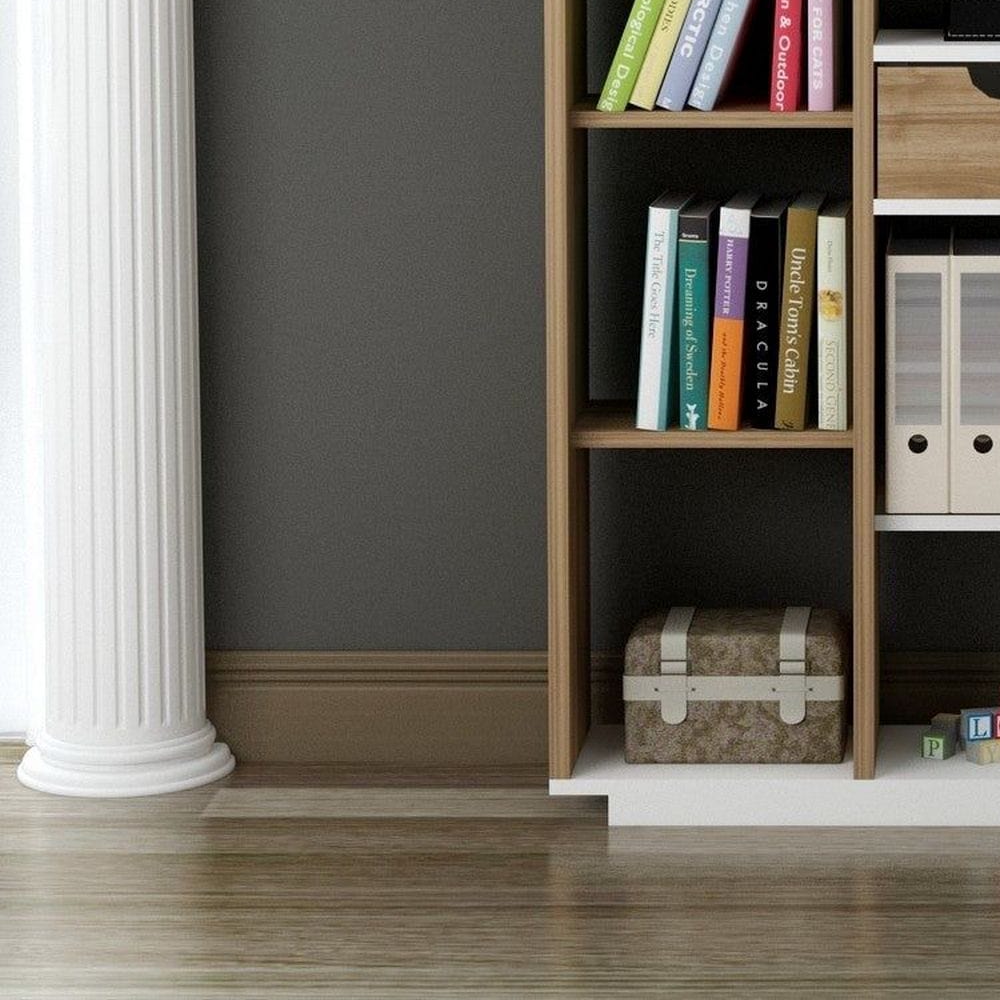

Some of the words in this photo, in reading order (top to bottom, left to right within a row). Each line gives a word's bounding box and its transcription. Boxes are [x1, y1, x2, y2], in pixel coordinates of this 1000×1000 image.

[780, 15, 792, 28] &
[812, 7, 822, 41] FOR
[776, 35, 790, 111] Outdoor
[812, 46, 823, 90] CATS
[654, 231, 665, 252] The
[724, 239, 734, 274] HARRY
[652, 255, 664, 278] Title
[789, 248, 806, 294] Uncle
[683, 268, 697, 327] Dreaming
[722, 275, 732, 314] POTTER
[686, 330, 698, 344] of
[786, 296, 804, 346] Tom's
[686, 344, 698, 390] Sweden
[756, 281, 768, 410] DRACULA
[826, 340, 836, 392] SECOND
[783, 348, 800, 394] Cabin
[928, 739, 940, 758] P
